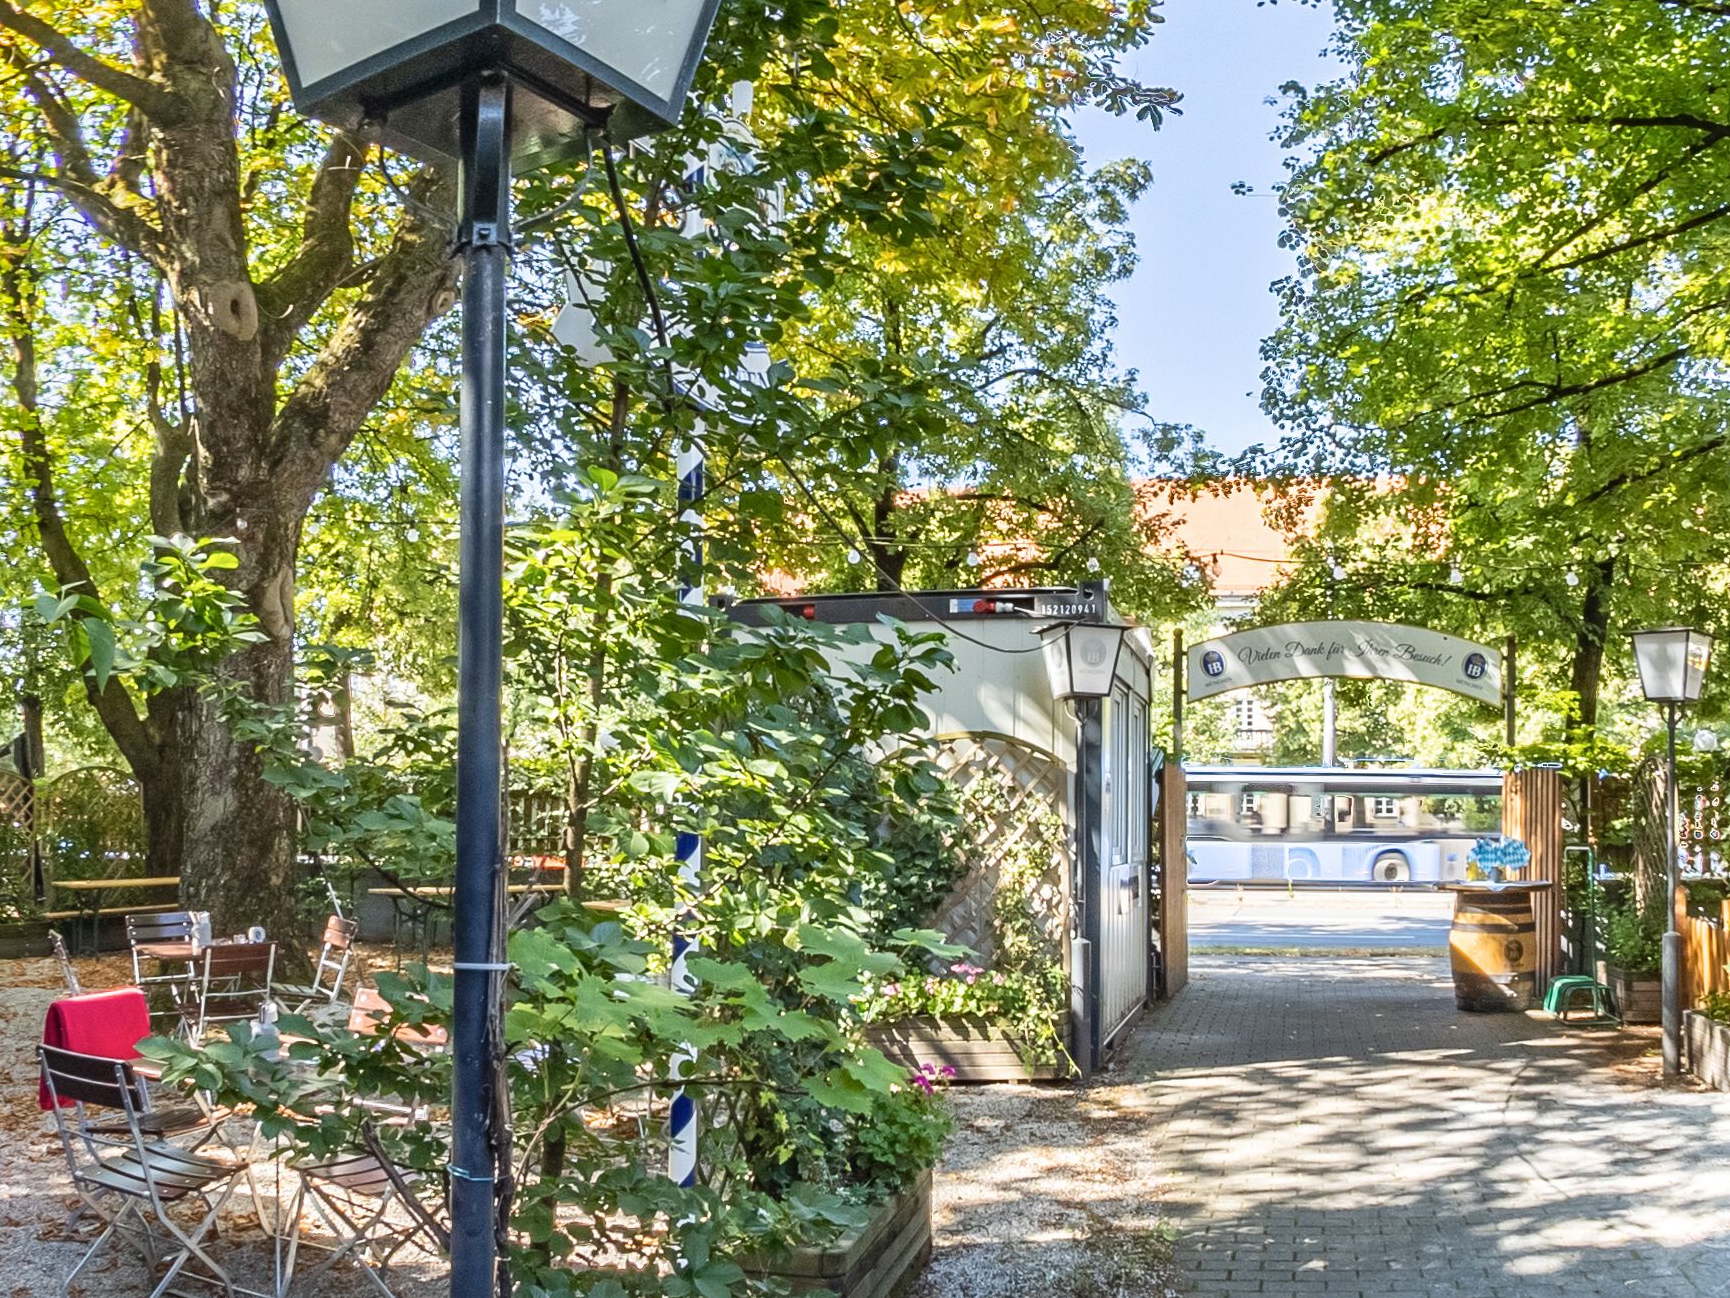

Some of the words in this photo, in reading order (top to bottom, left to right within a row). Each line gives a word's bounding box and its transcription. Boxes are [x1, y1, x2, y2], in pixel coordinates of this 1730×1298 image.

[1041, 604, 1097, 615] 152120941
[1238, 646, 1280, 665] Vielen
[1285, 641, 1325, 658] Dank
[1327, 641, 1346, 661] für
[1355, 638, 1389, 657] Ihren
[1393, 643, 1452, 667] Besuch!
[1208, 662, 1223, 675] HB
[1467, 663, 1482, 677] HB
